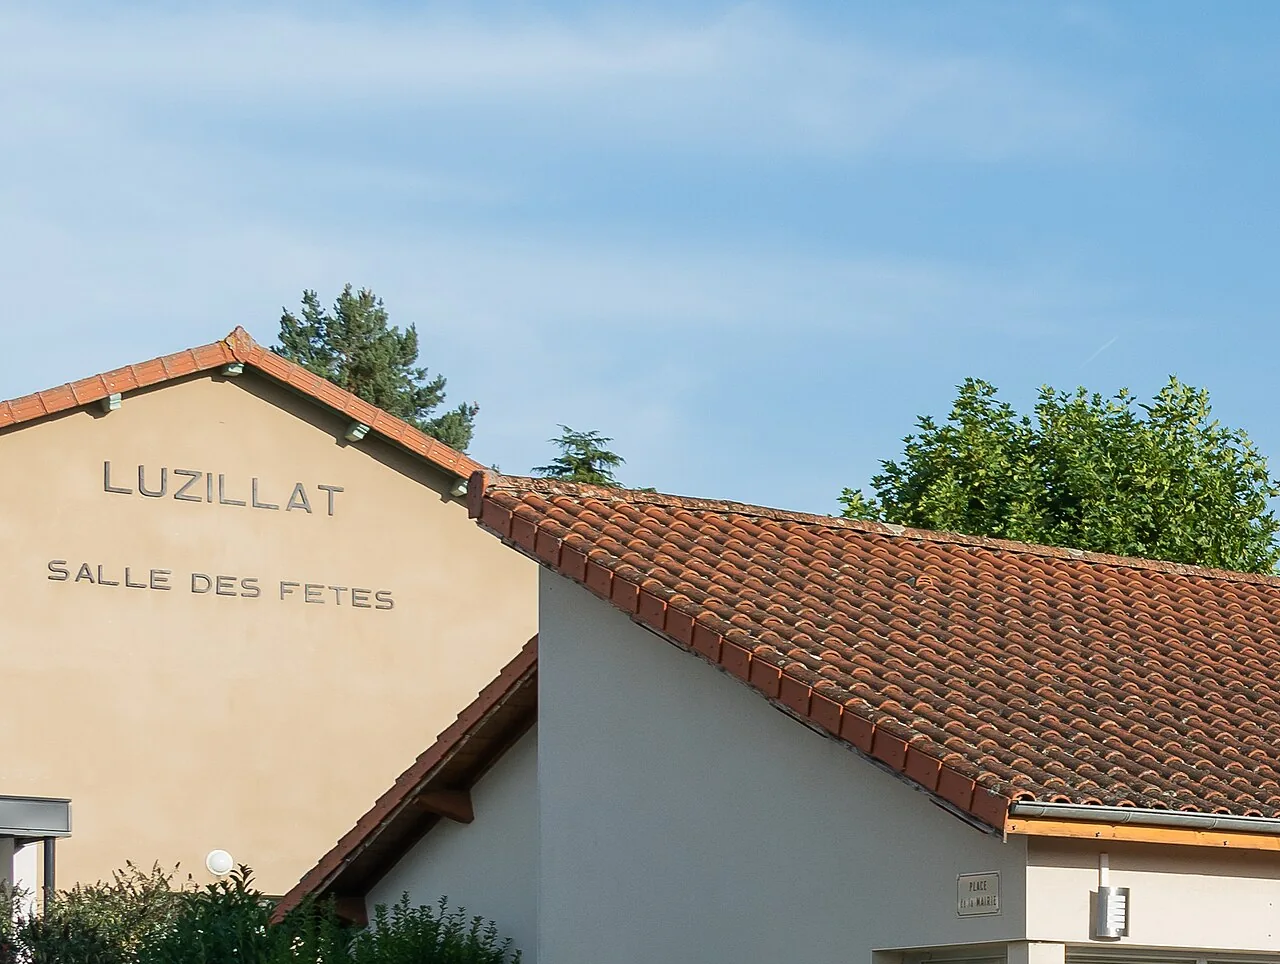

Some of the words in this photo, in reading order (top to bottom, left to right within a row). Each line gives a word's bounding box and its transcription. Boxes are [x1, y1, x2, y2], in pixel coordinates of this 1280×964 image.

[103, 460, 345, 517] LUZILLAT
[47, 559, 172, 591] SALLE
[191, 572, 262, 598] DES
[279, 581, 396, 610] FETES
[969, 880, 987, 891] PLACE
[976, 895, 997, 906] MAIRIE
